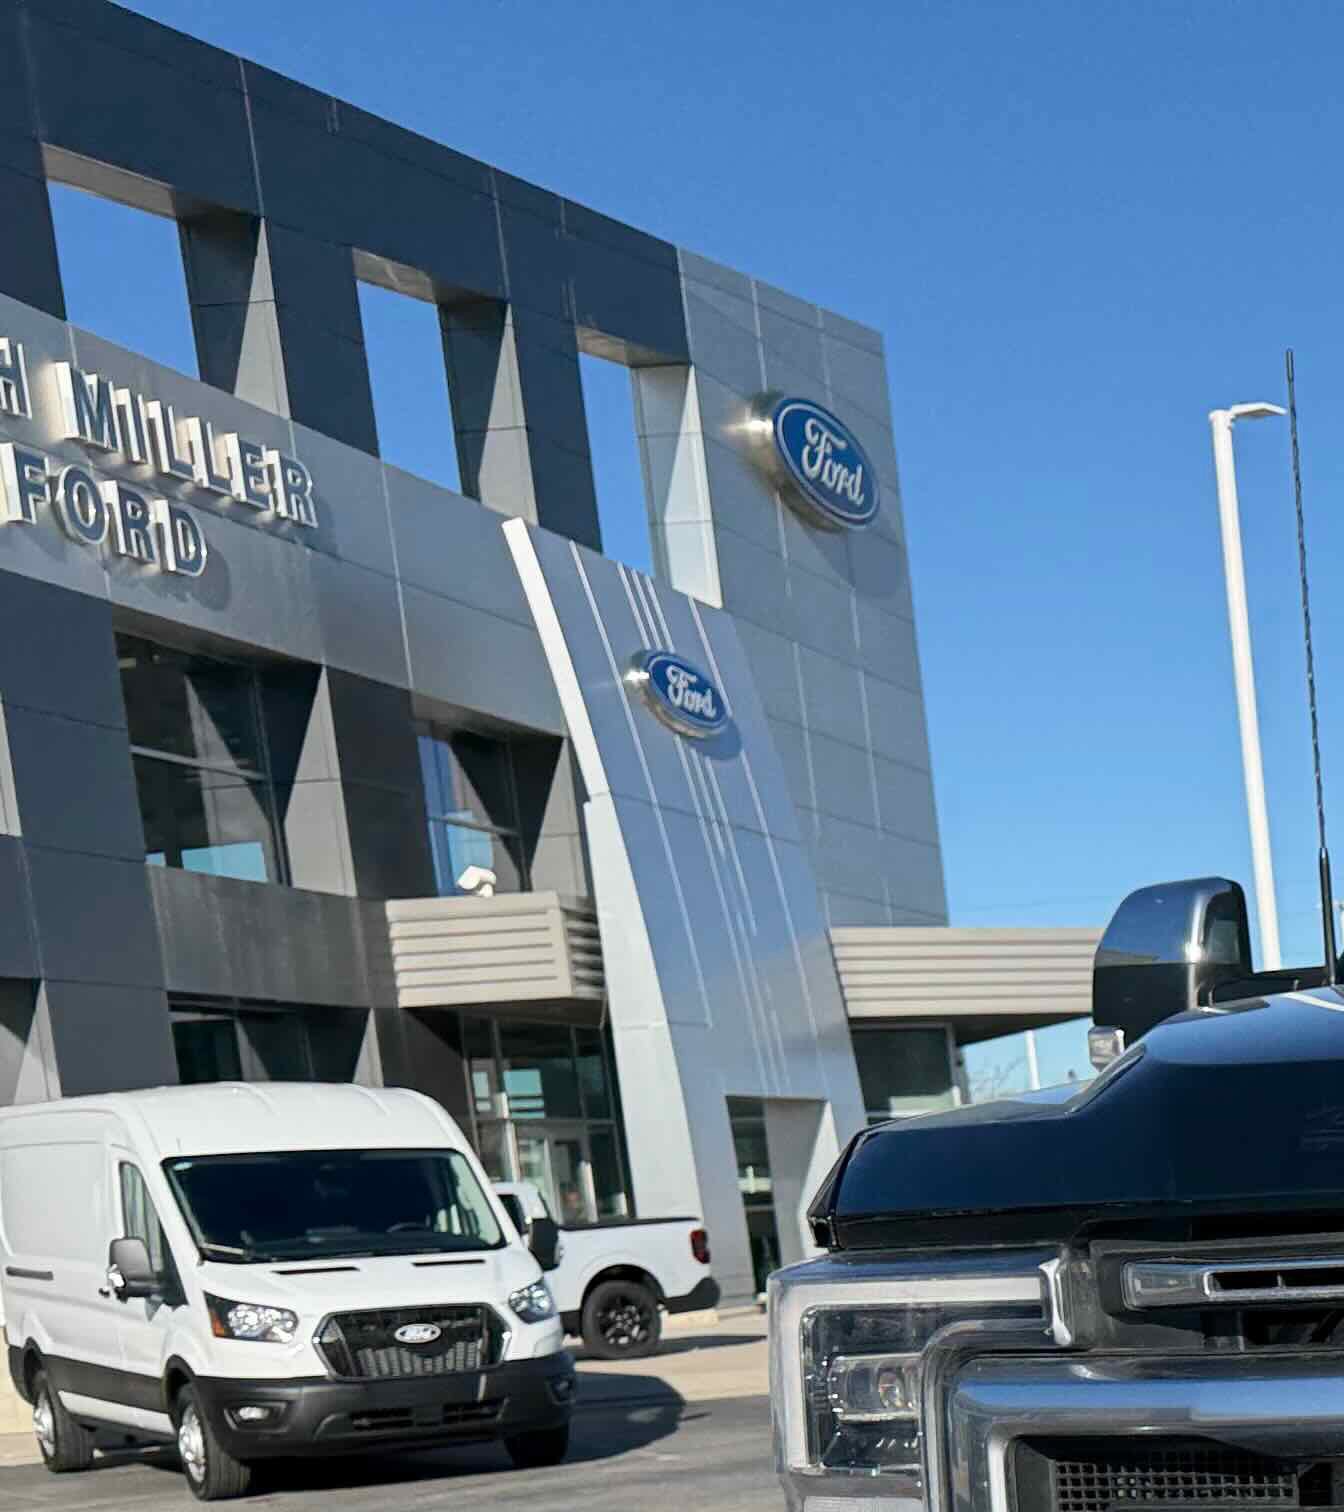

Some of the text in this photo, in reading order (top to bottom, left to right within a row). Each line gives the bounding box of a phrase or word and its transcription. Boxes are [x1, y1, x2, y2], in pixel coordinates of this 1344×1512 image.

[50, 361, 319, 528] MILLER
[802, 418, 865, 506] Ford
[0, 442, 207, 577] FORD
[666, 665, 717, 718] Ford
